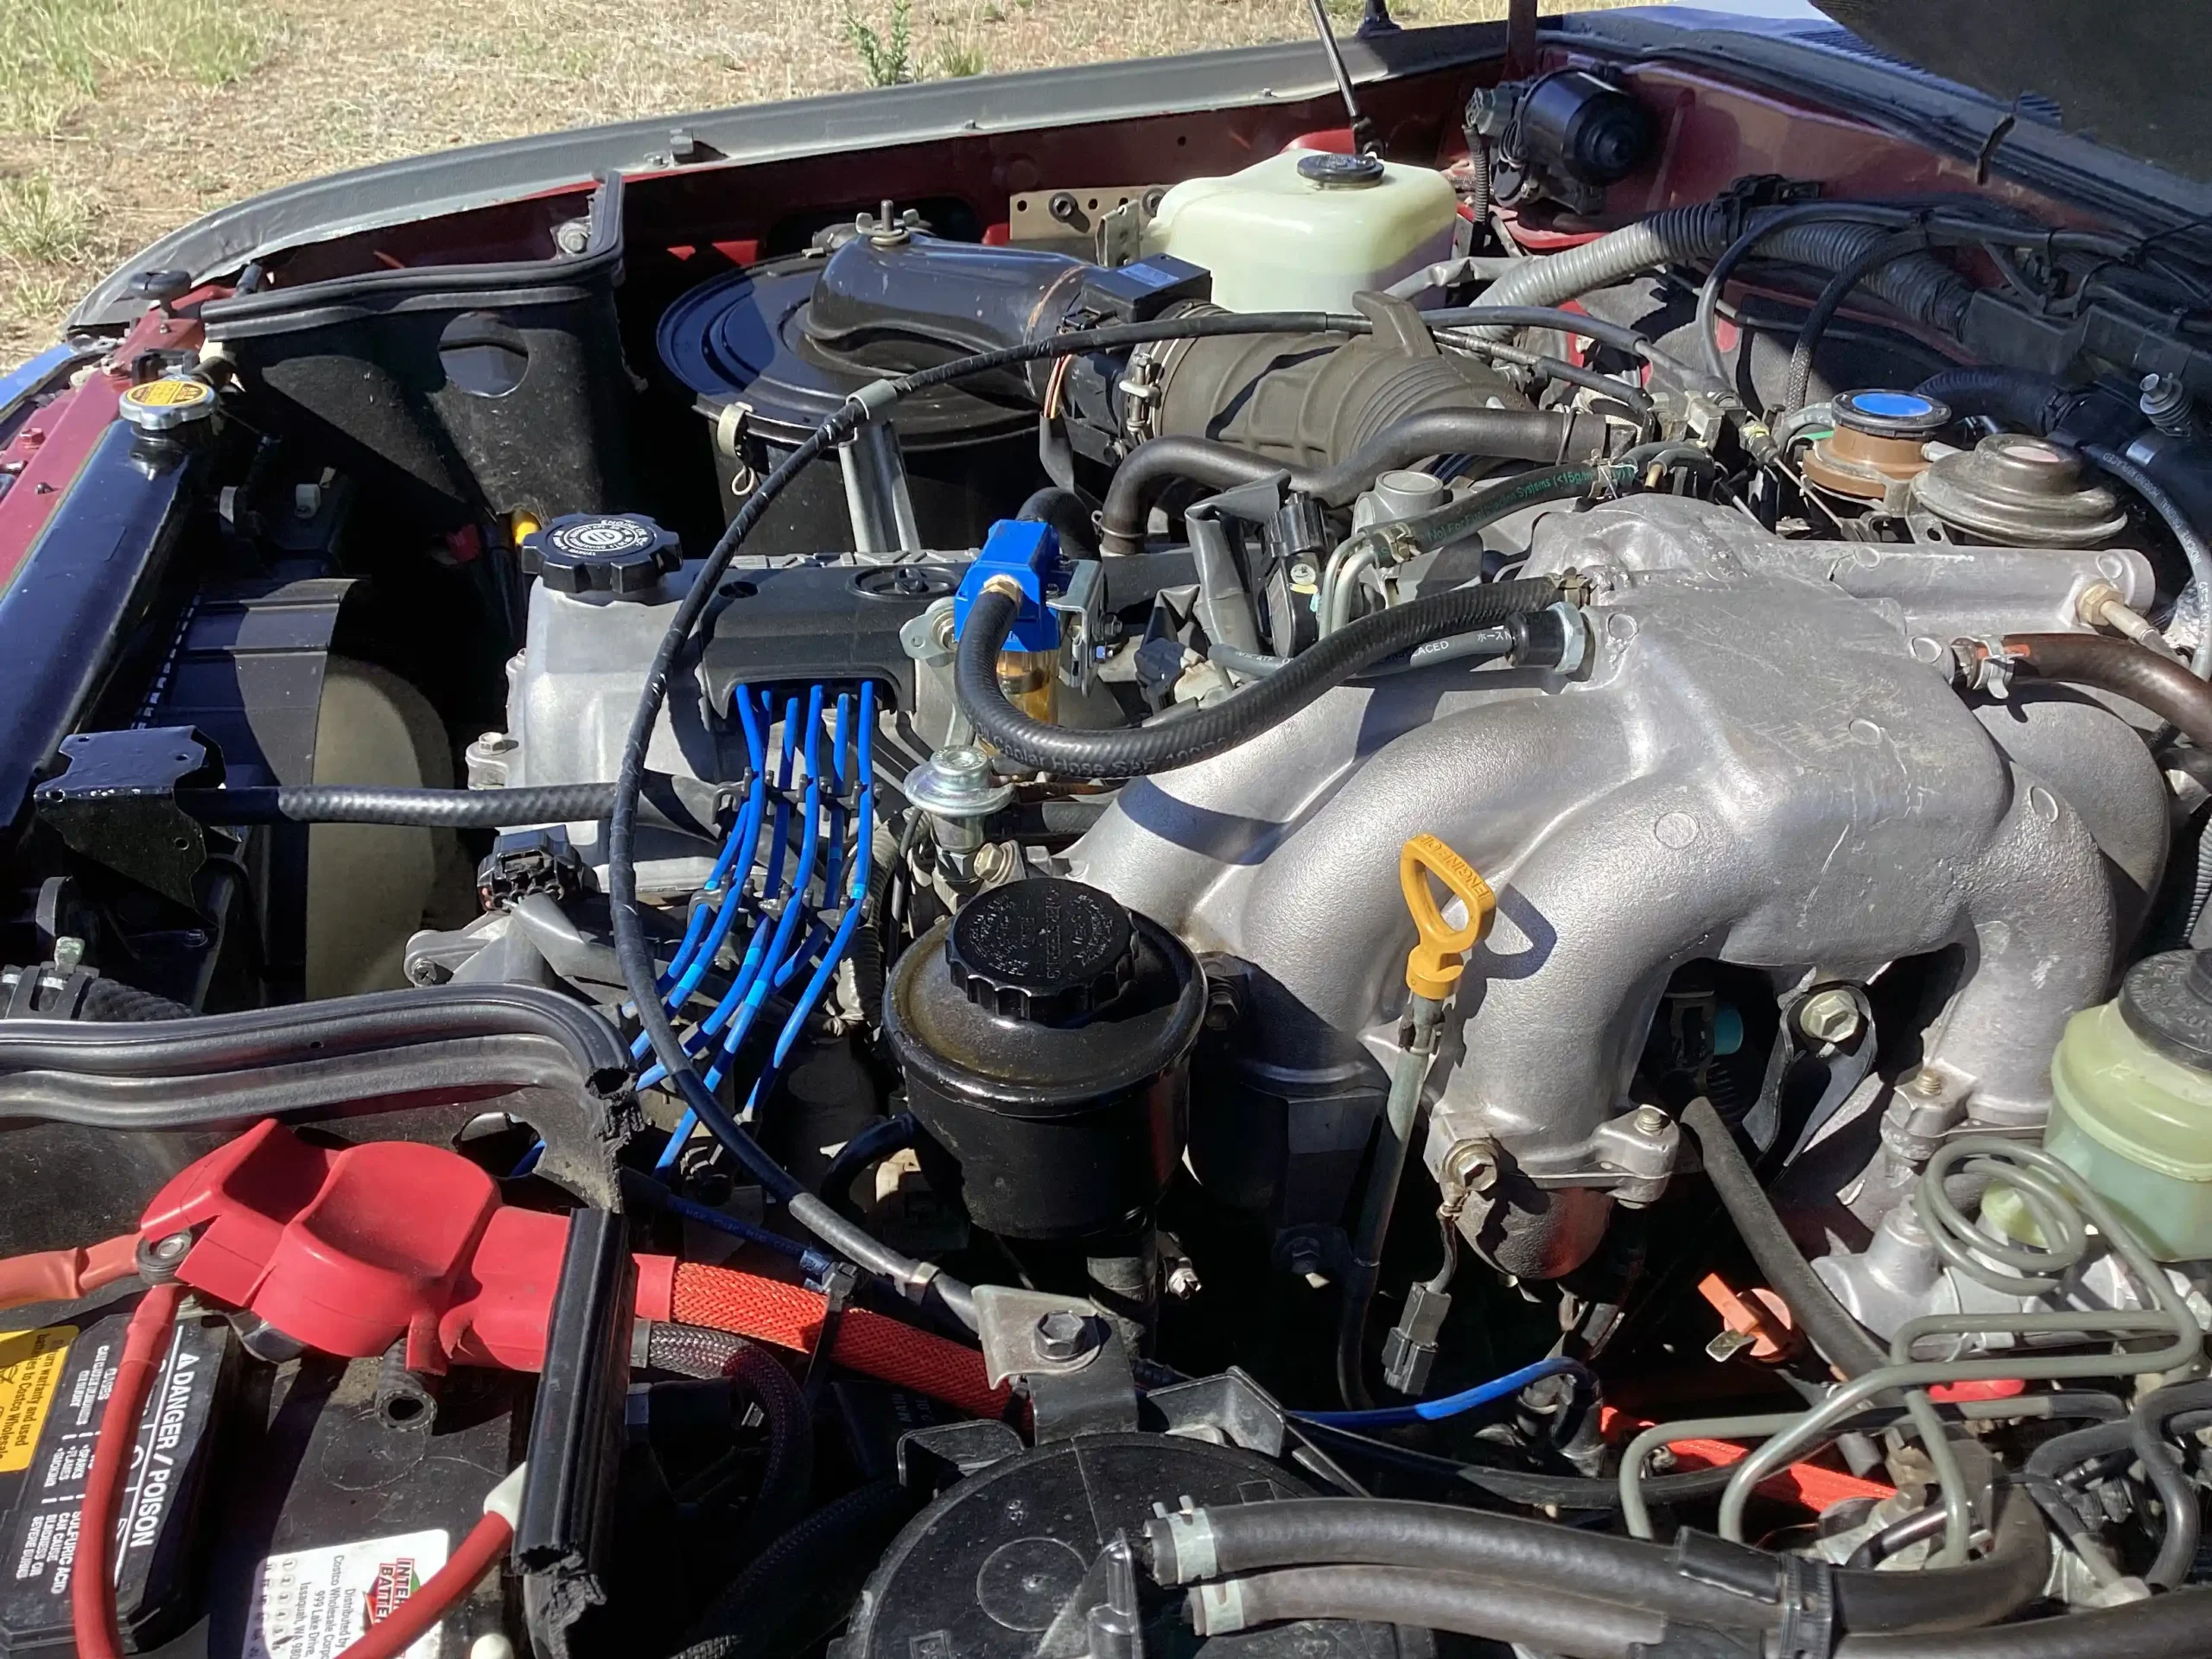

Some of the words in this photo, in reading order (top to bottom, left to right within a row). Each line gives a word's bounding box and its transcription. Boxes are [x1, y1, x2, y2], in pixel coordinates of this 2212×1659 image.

[1517, 477, 1551, 498] Systems
[601, 519, 639, 530] ENGINE
[1052, 756, 1105, 776] Hose
[1421, 836, 1442, 851] OIL
[1443, 854, 1491, 899] ENGINE
[22, 1371, 36, 1382] to
[27, 1368, 51, 1405] warranty
[10, 1382, 33, 1413] Costco
[156, 1370, 196, 1451] DANGER
[892, 1393, 913, 1422] MAIN
[22, 1406, 37, 1422] and
[14, 1425, 30, 1446] used
[154, 1452, 173, 1466] /
[55, 1512, 71, 1530] CAN
[130, 1470, 170, 1547] POISON
[24, 1516, 44, 1548] SEVERE
[59, 1510, 82, 1565] SULFURIC
[47, 1533, 66, 1562] CAUSE
[50, 1567, 72, 1594] ACID
[332, 1554, 345, 1586] Costco
[293, 1582, 312, 1624] Issaquah,
[313, 1590, 326, 1607] 999
[325, 1586, 341, 1632] Wholesale
[308, 1609, 322, 1631] Lake
[340, 1588, 356, 1637] Distributed
[292, 1625, 306, 1641] WA
[304, 1632, 321, 1657] Drive,
[335, 1637, 350, 1649] by
